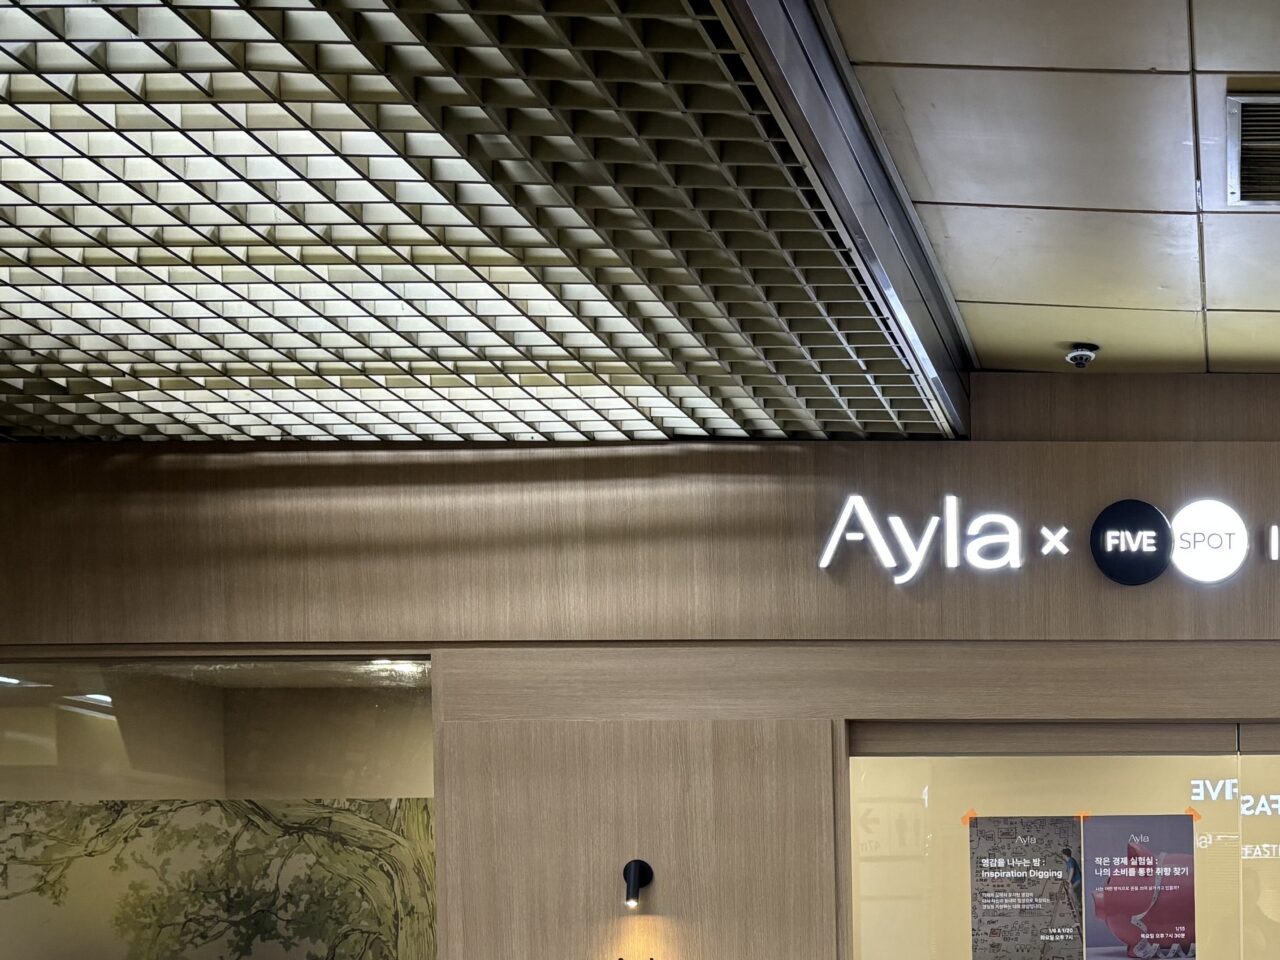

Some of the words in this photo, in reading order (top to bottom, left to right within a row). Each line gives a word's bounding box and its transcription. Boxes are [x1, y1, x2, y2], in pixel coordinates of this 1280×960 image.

[818, 493, 1024, 585] Ayla
[1104, 530, 1158, 553] FIVE
[1178, 529, 1237, 552] SPOT
[1015, 836, 1036, 846] Ayla
[1128, 834, 1150, 844] Ayla
[982, 858, 1005, 867] 영감을
[1007, 858, 1030, 867] 나누는
[1033, 858, 1040, 867] 밤
[1095, 857, 1110, 866] 작은
[1113, 857, 1128, 866] 경제
[1130, 857, 1153, 865] 실험실
[982, 870, 1027, 880] Inspiration
[1030, 869, 1062, 879] Digging
[1095, 868, 1110, 876] 나의
[1113, 868, 1136, 876] 소비를
[1138, 868, 1153, 876] 통한
[1156, 867, 1171, 876] 취향
[1173, 867, 1188, 876] 찾기
